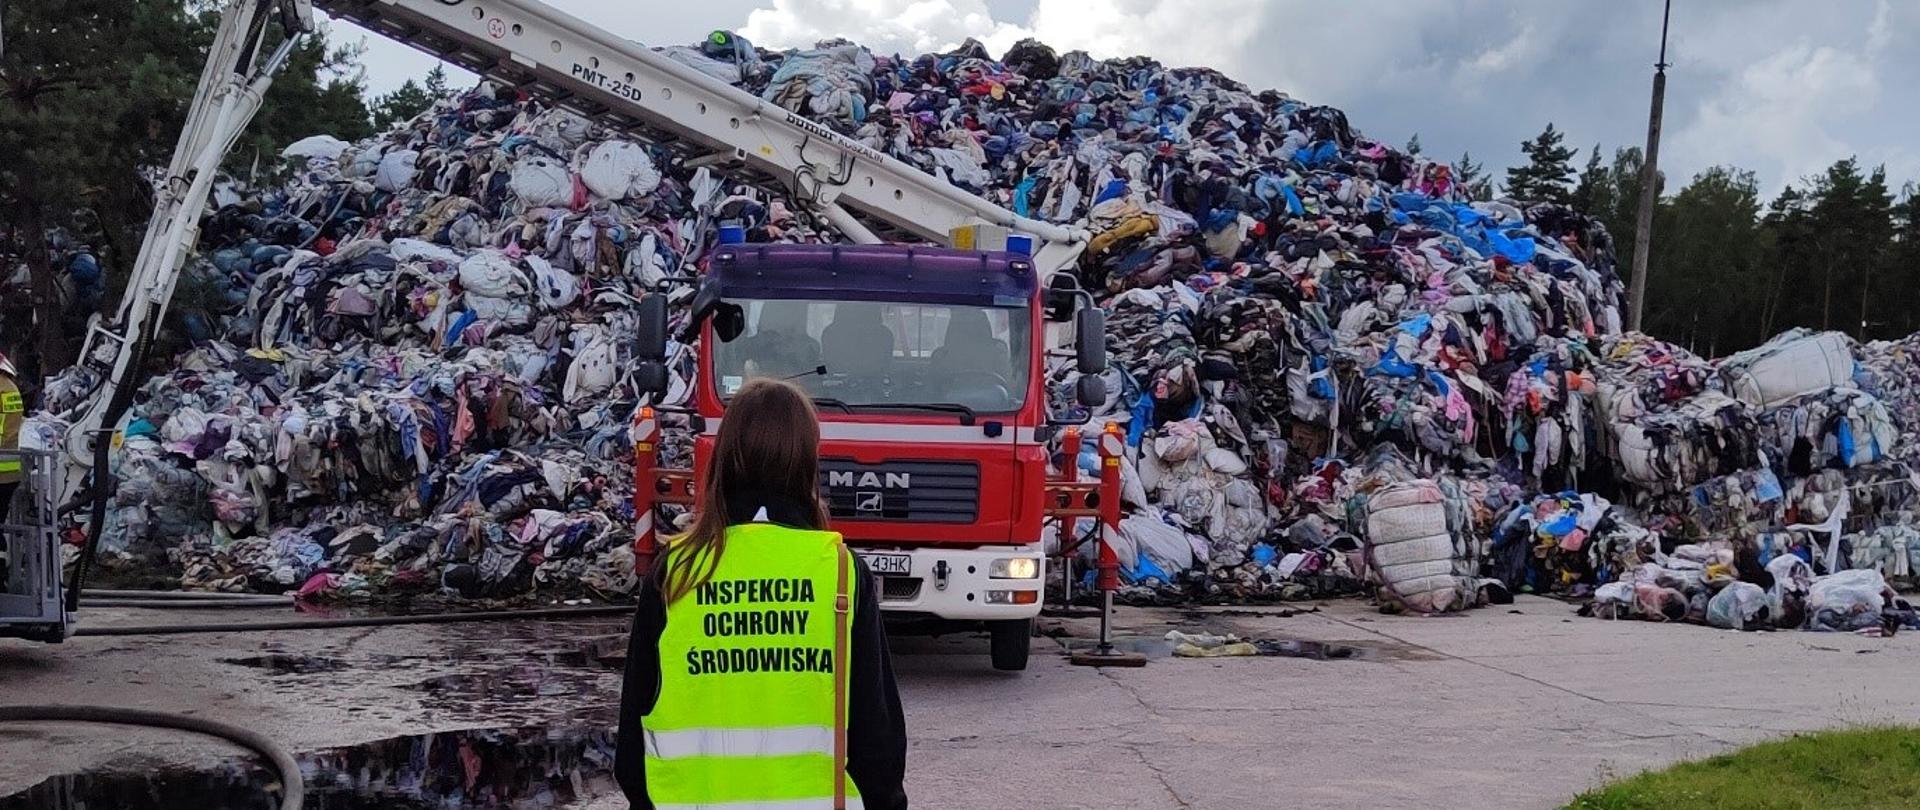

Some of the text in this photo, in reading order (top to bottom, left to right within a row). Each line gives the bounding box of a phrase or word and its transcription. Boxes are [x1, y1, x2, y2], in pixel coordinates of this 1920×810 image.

[572, 63, 642, 101] PMT-25D
[829, 471, 910, 488] MAN
[696, 578, 815, 605] INSPEKCJA
[703, 610, 809, 637] OCHRONY
[686, 646, 833, 675] ŚRODOWISKA
